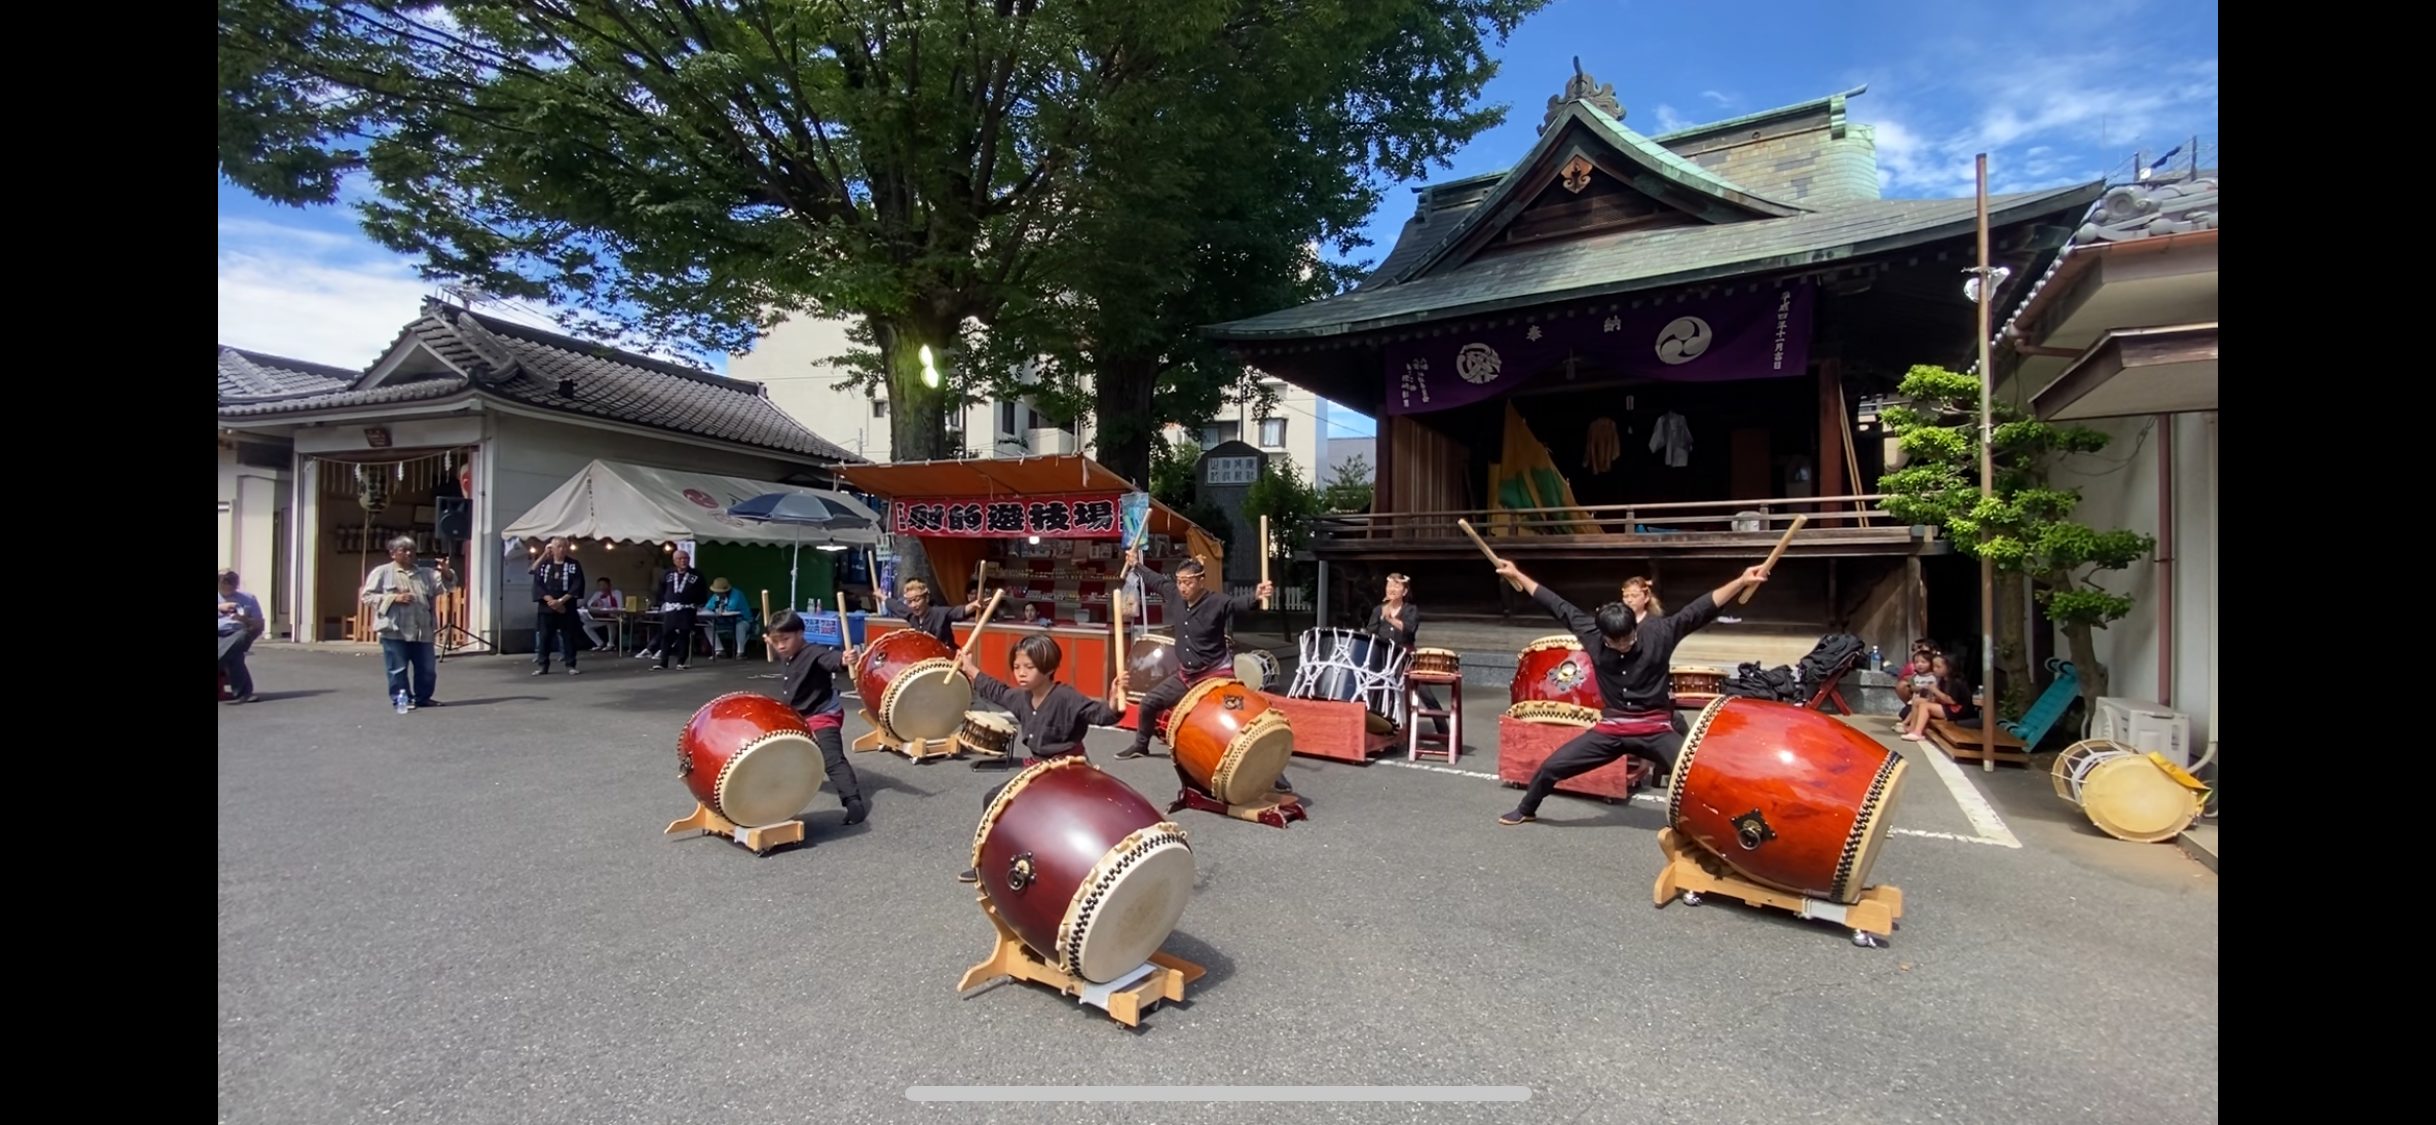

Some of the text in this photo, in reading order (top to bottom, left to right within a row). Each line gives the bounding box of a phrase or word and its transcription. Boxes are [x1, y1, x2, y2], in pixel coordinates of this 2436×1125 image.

[908, 500, 1114, 533] 射的遊技場
